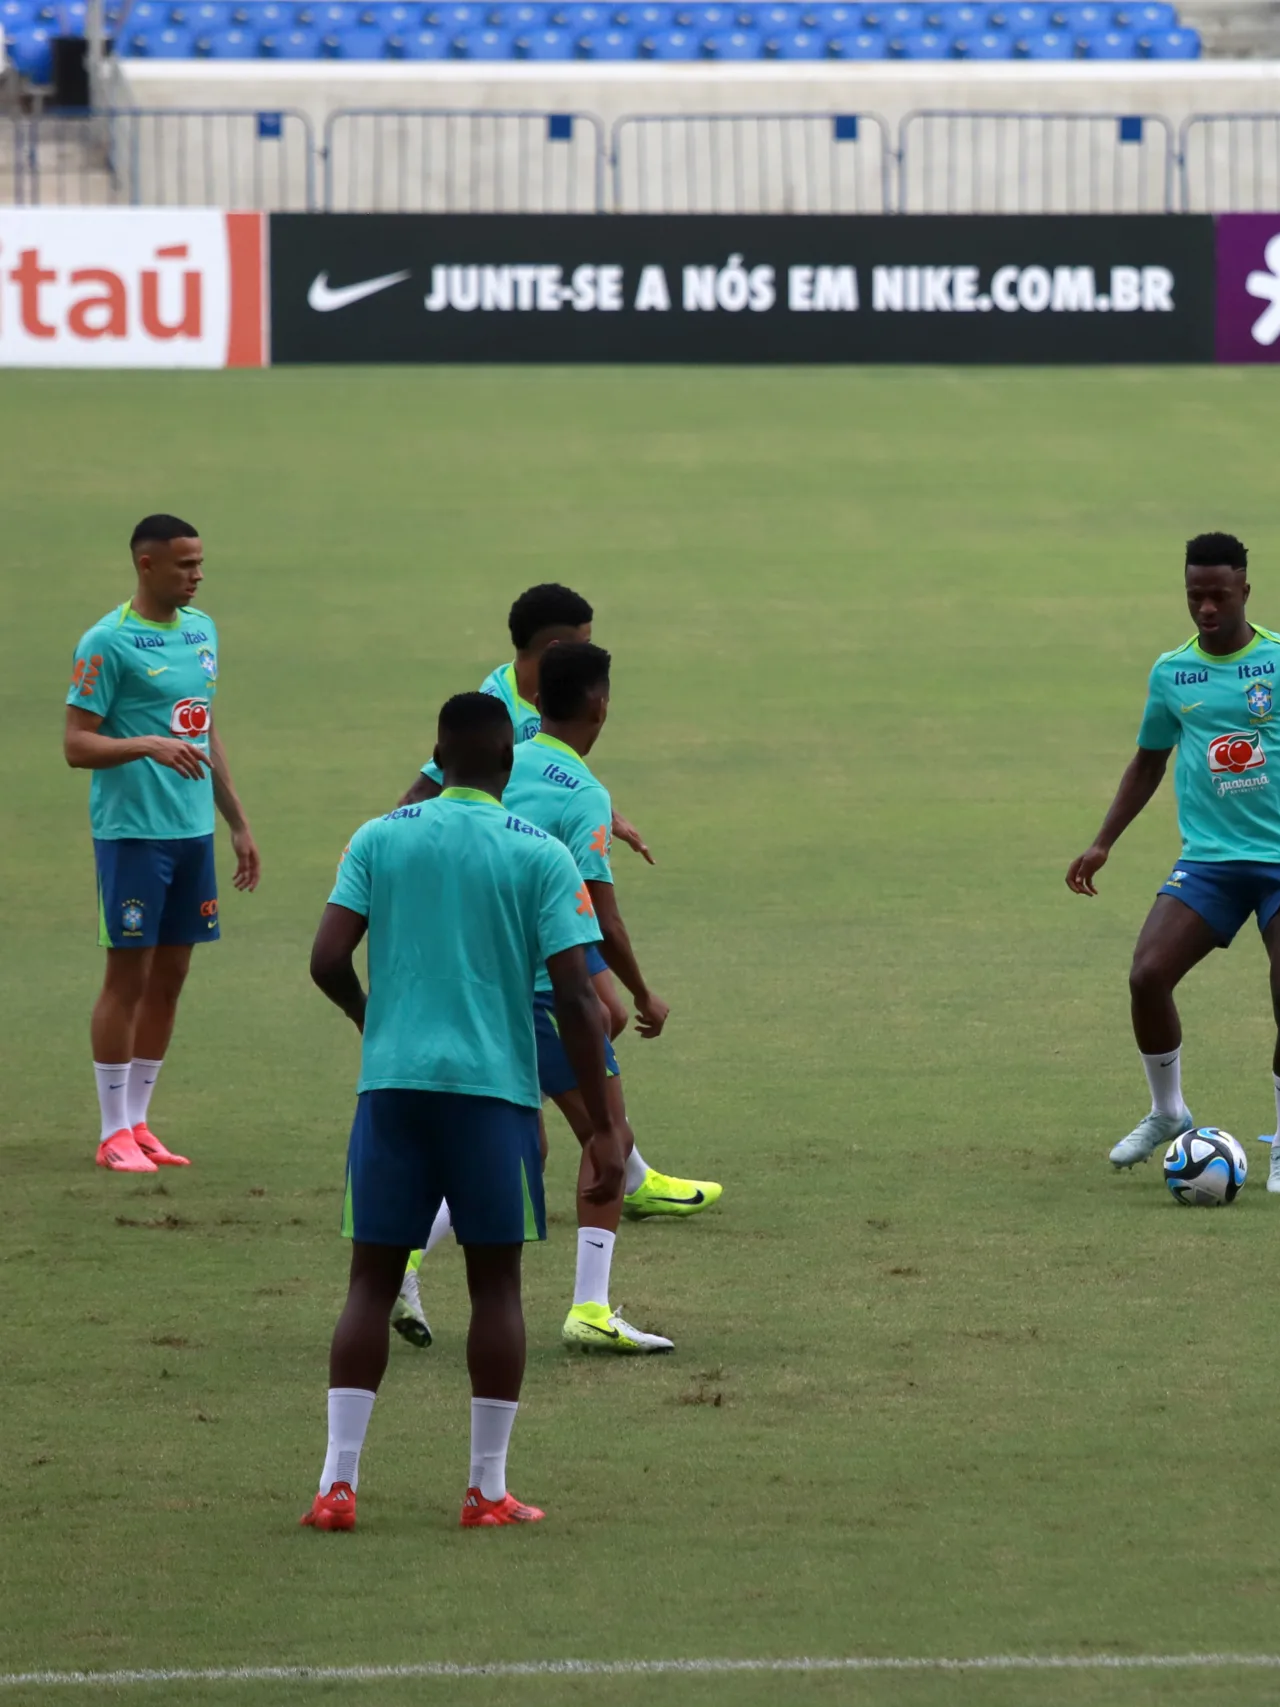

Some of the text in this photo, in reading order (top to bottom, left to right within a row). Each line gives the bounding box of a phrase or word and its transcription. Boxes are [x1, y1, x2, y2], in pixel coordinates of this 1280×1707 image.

[0, 243, 202, 340] taú
[424, 252, 1175, 313] JUNTE-SE A NÓS EM NIKE.COM.BR
[133, 634, 165, 649] Itaú
[181, 630, 208, 645] Itaú
[1174, 668, 1209, 686] Itaú
[1238, 660, 1276, 680] Itaú
